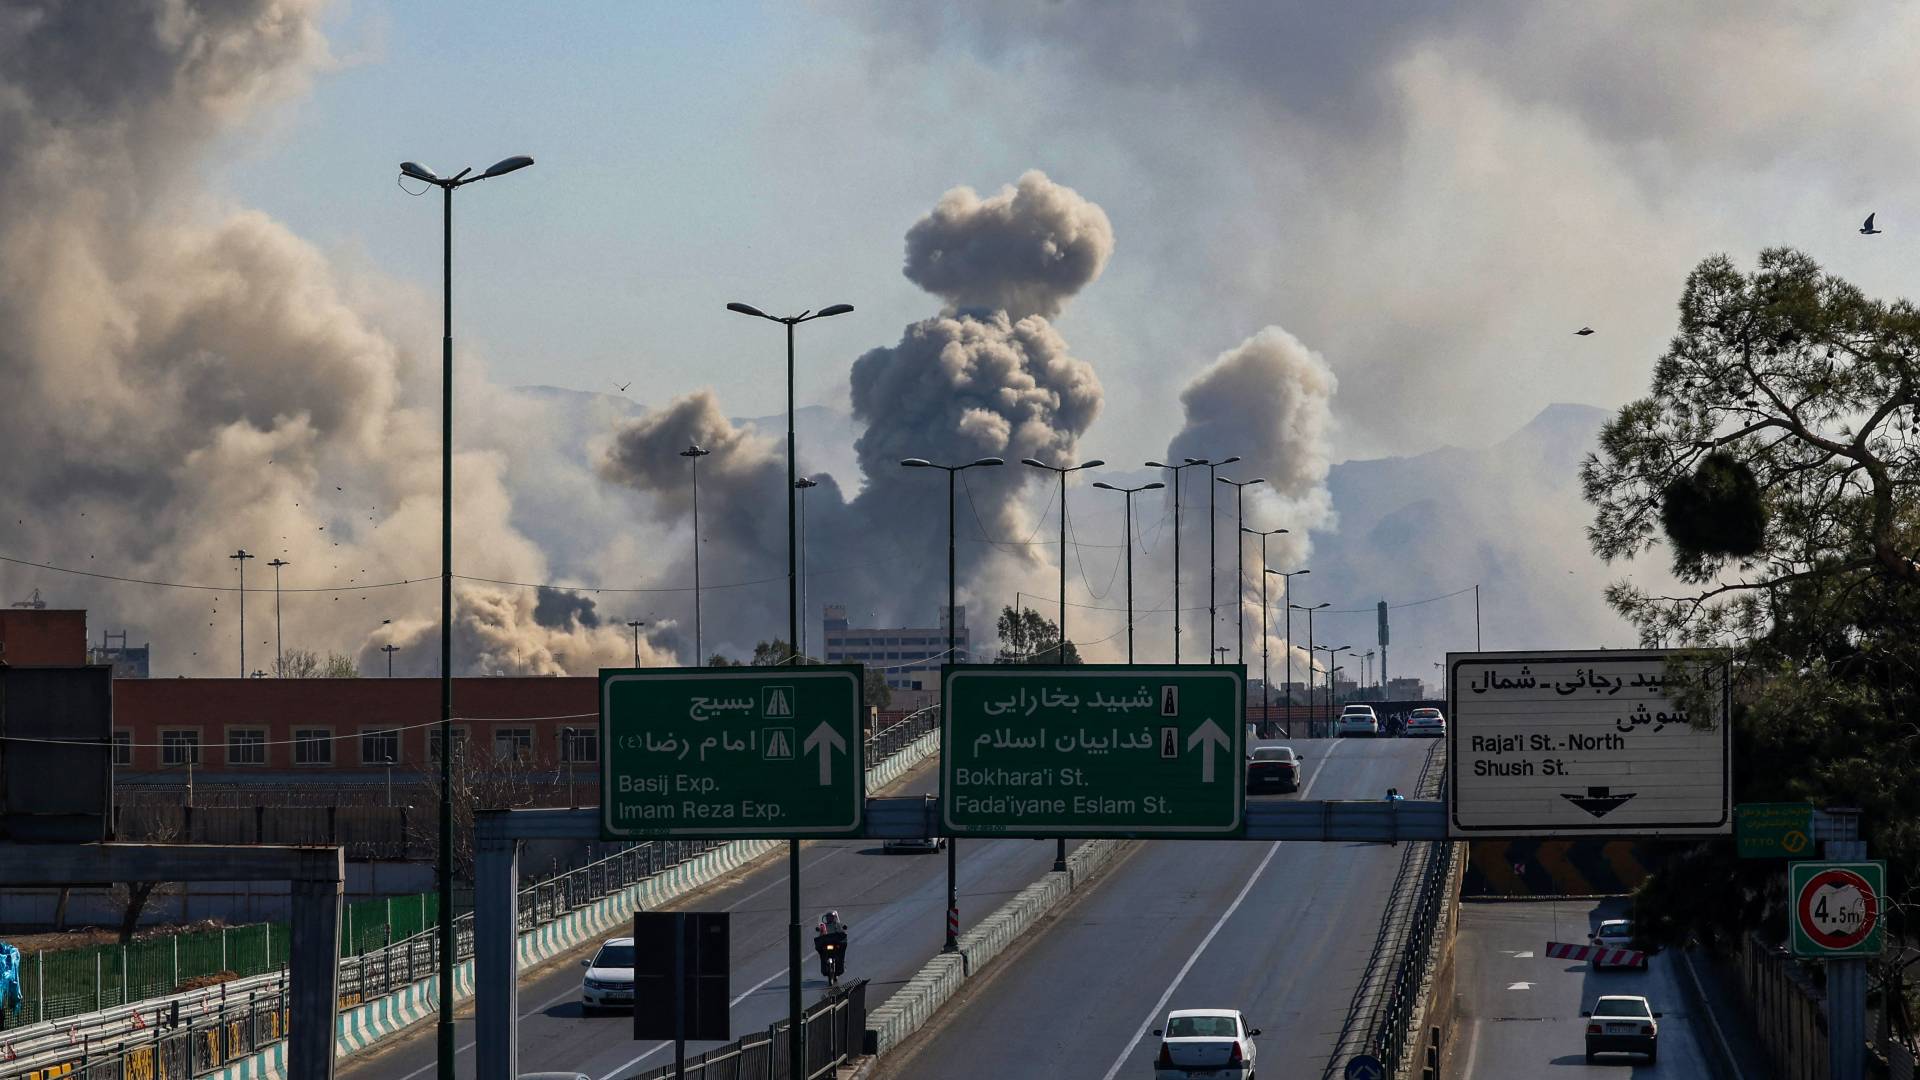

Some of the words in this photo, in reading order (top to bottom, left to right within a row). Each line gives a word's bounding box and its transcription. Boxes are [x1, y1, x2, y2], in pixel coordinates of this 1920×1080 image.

[1471, 665, 1537, 694] شمال
[689, 696, 755, 721] بسیج
[983, 687, 1080, 716] بخارایی
[1087, 685, 1153, 713] شهید
[700, 730, 756, 762] امام
[973, 728, 1046, 758] اسلام
[1054, 726, 1153, 755] فداییان
[1471, 735, 1524, 755] Raja'i
[956, 767, 1053, 787] Bokhara'i
[1059, 768, 1090, 787] St.
[1473, 759, 1534, 777] Shush
[1542, 759, 1569, 776] St.
[618, 774, 669, 796] Basij
[676, 774, 720, 795] Exp.
[618, 802, 675, 819] Imam
[682, 801, 735, 819] Reza
[742, 800, 787, 820] Exp.
[955, 795, 1066, 818] Fada'iyane
[1073, 795, 1136, 814] Eslam
[1142, 795, 1174, 815] St.
